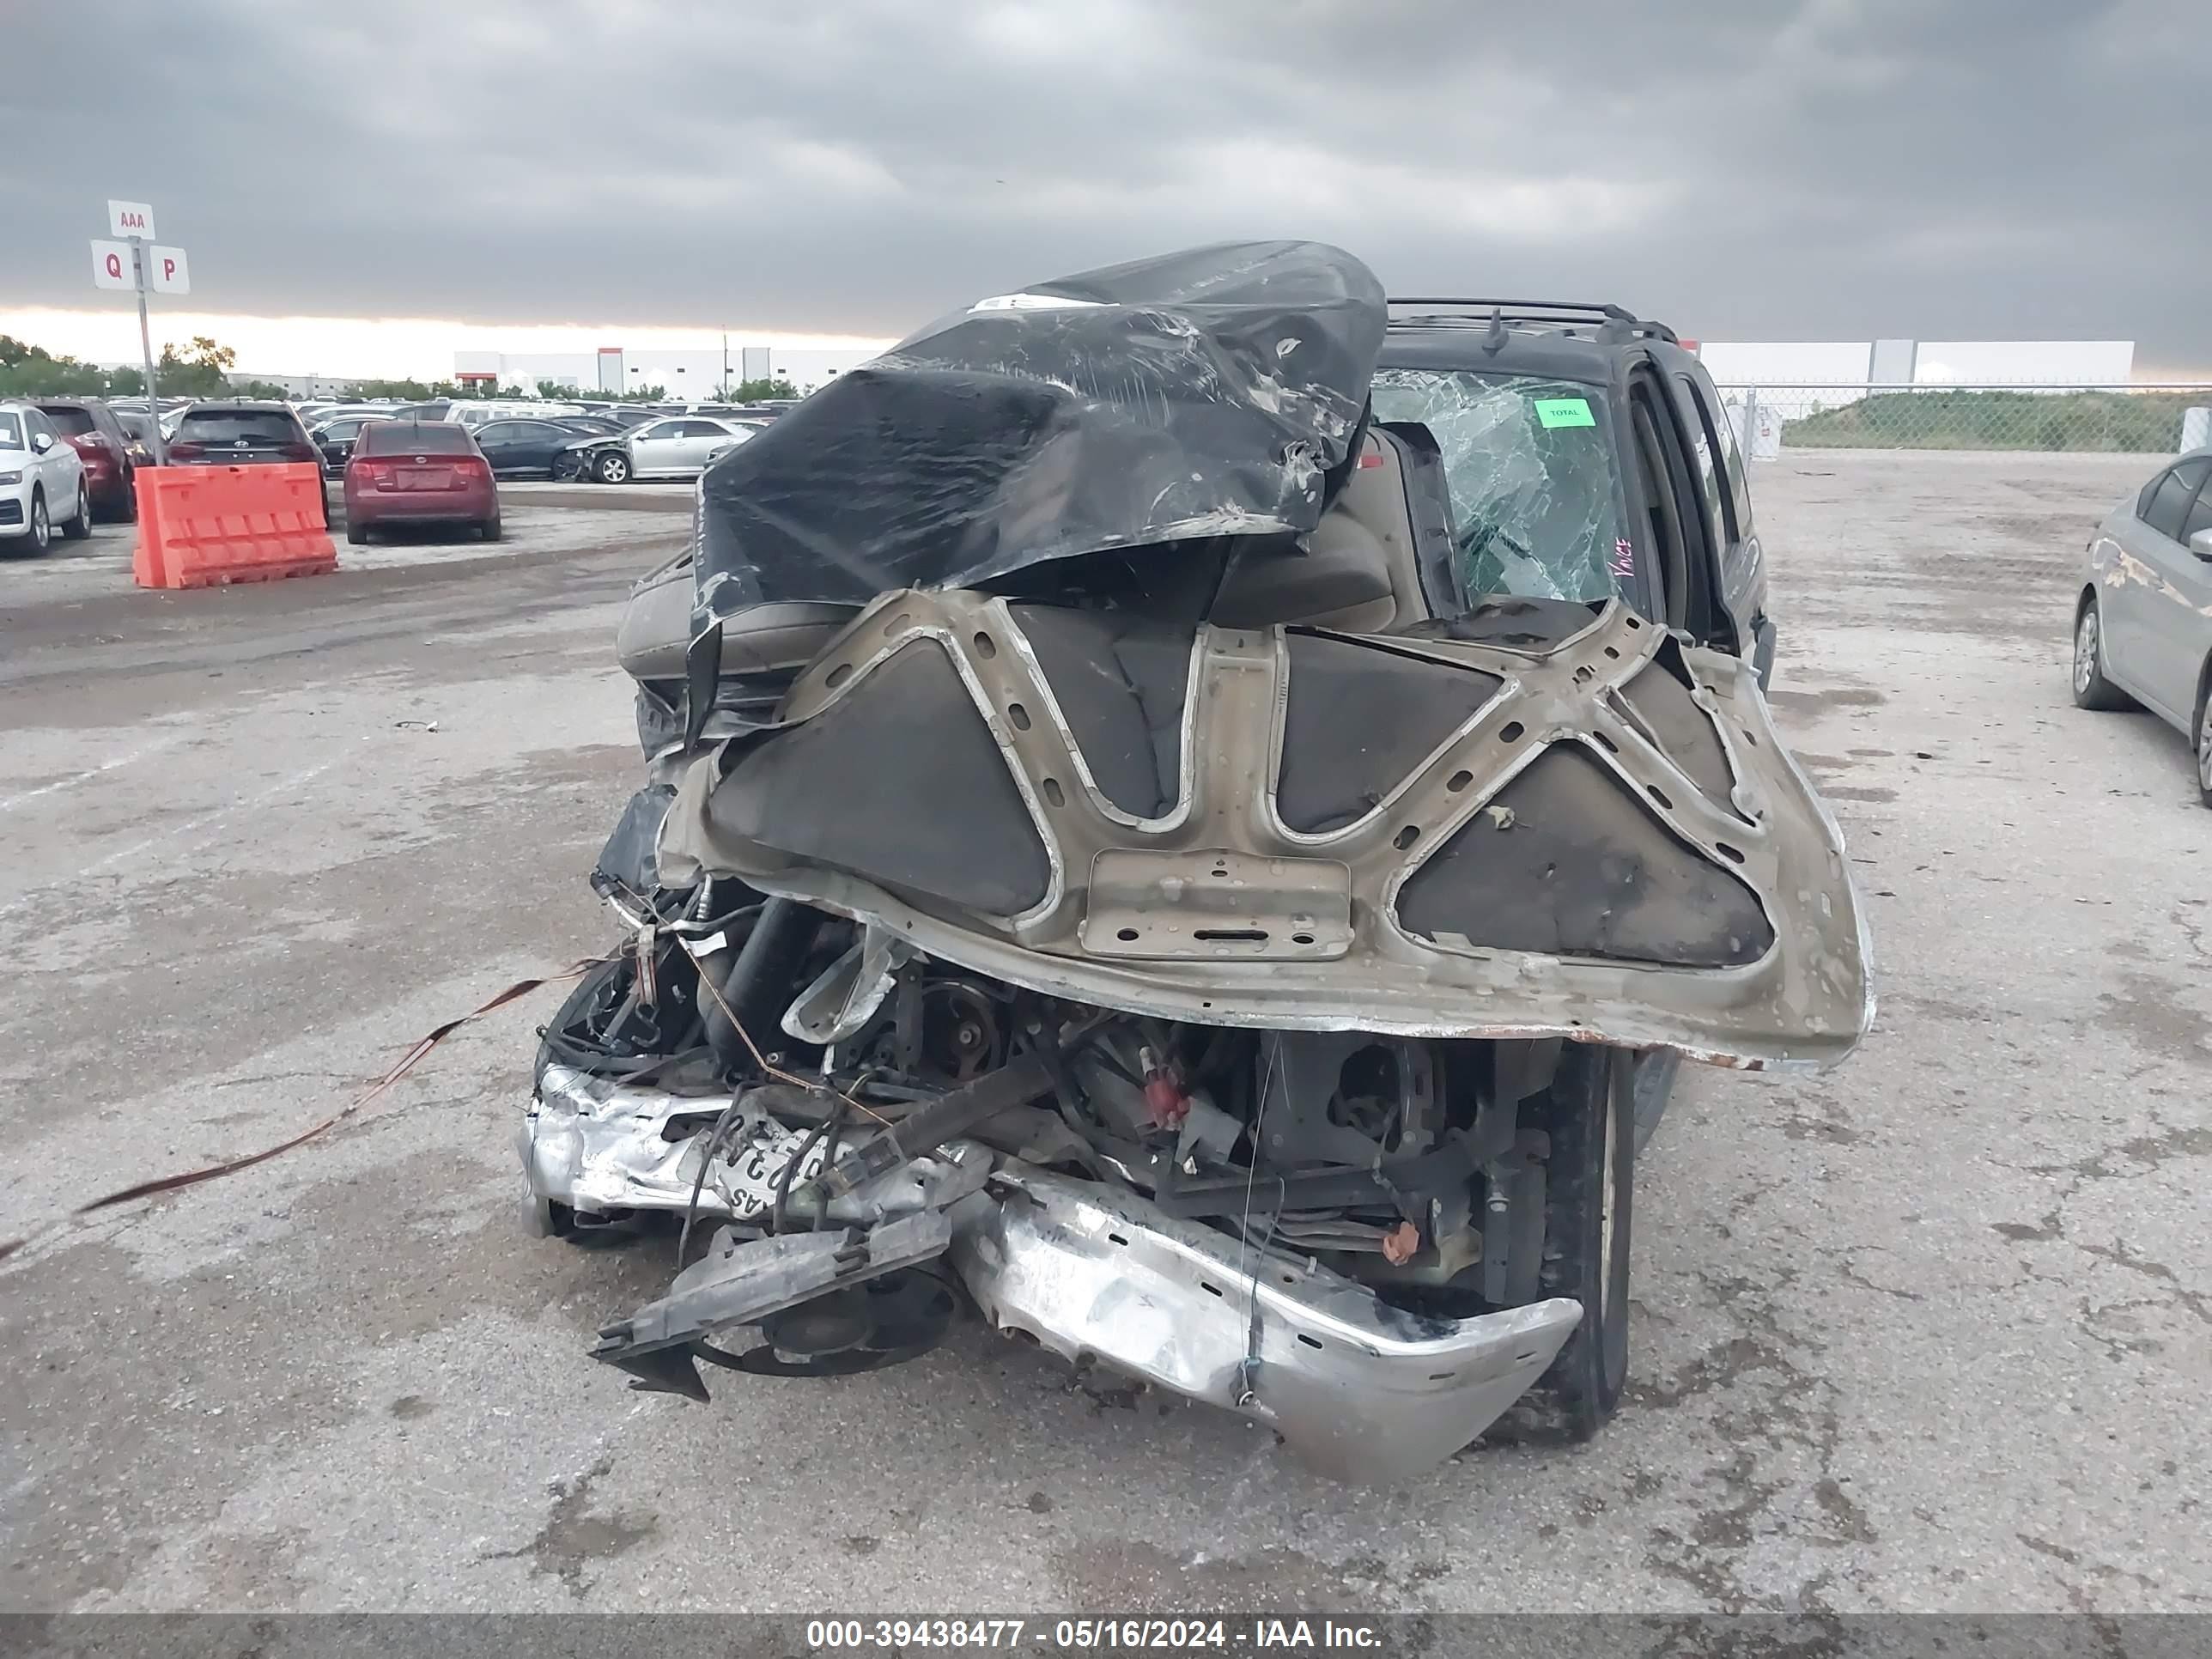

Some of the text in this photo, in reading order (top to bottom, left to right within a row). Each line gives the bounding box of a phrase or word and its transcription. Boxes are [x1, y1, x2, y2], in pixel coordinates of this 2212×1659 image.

[120, 212, 144, 228] AAA
[106, 253, 122, 279] Q
[164, 258, 175, 282] P
[1549, 409, 1581, 417] TOTAL
